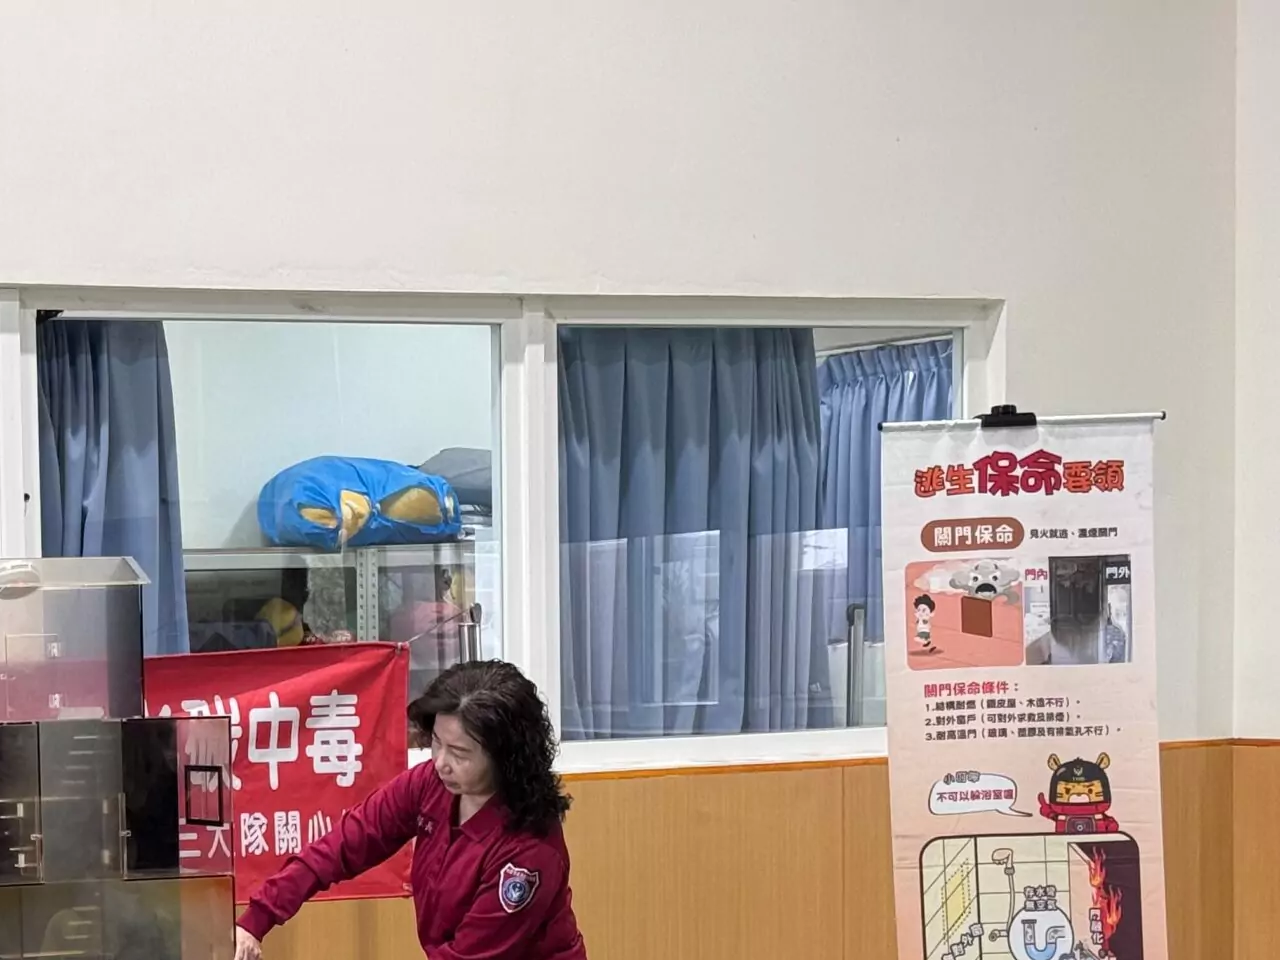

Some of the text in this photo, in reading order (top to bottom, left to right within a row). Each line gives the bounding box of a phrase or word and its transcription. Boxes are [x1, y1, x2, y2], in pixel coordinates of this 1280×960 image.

[914, 449, 1125, 498] 逃生保命要領
[934, 524, 1015, 547] 關門保命
[1024, 568, 1048, 581] 門內
[1105, 566, 1130, 579] 門外
[924, 681, 1019, 698] 關門保命條件：
